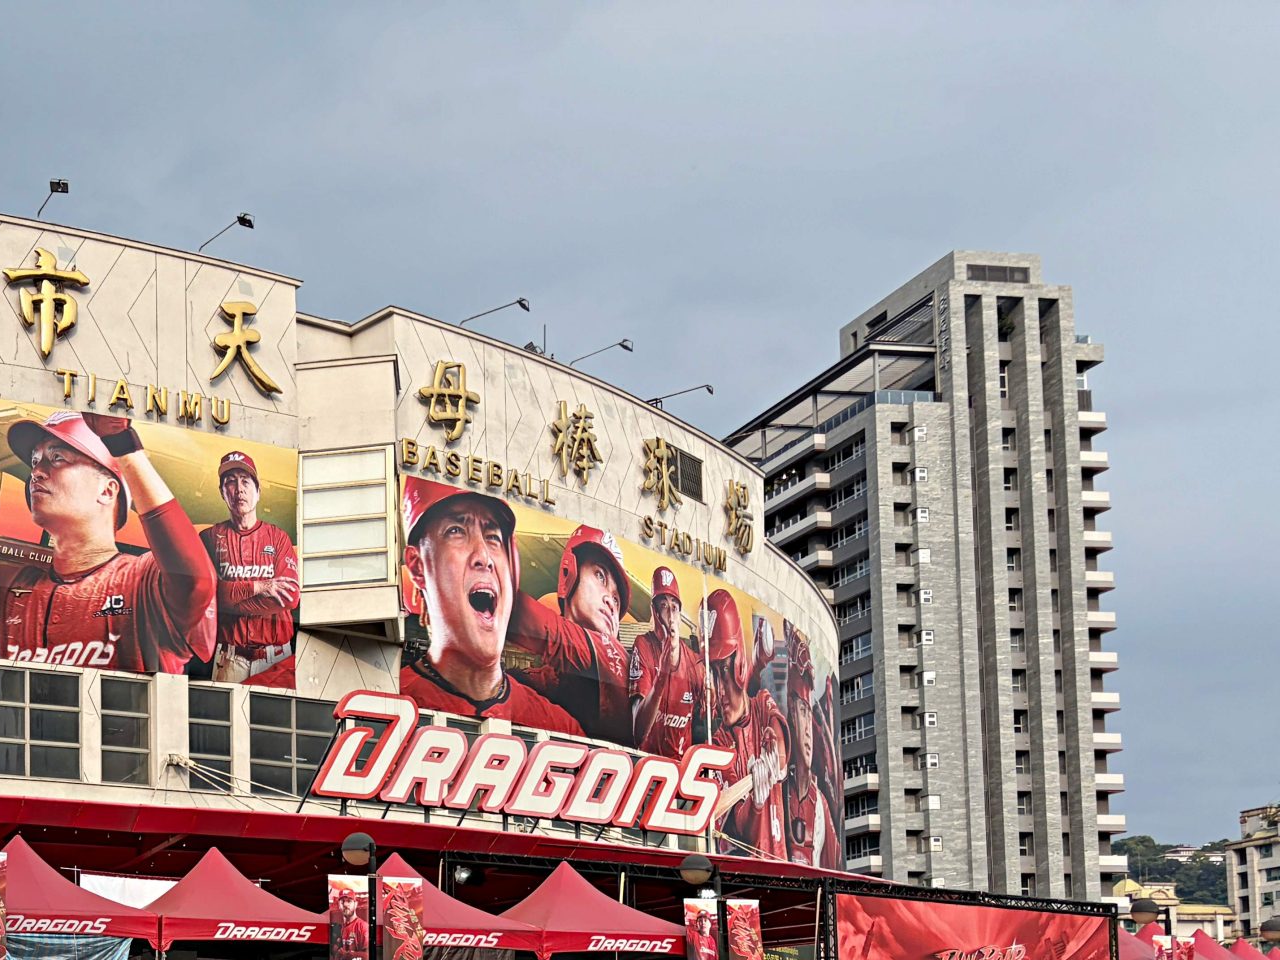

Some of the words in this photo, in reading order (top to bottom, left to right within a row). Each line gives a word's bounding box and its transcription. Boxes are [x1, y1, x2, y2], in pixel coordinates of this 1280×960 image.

[56, 369, 233, 426] TIANMU
[402, 437, 556, 506] BASEBALL
[641, 514, 728, 573] STADIUM
[28, 551, 53, 564] CLUB
[313, 690, 736, 836] DRAGONS
[5, 914, 112, 934] DRAGONS
[213, 922, 317, 941] DRAGONS
[587, 935, 674, 953] DRAGONS
